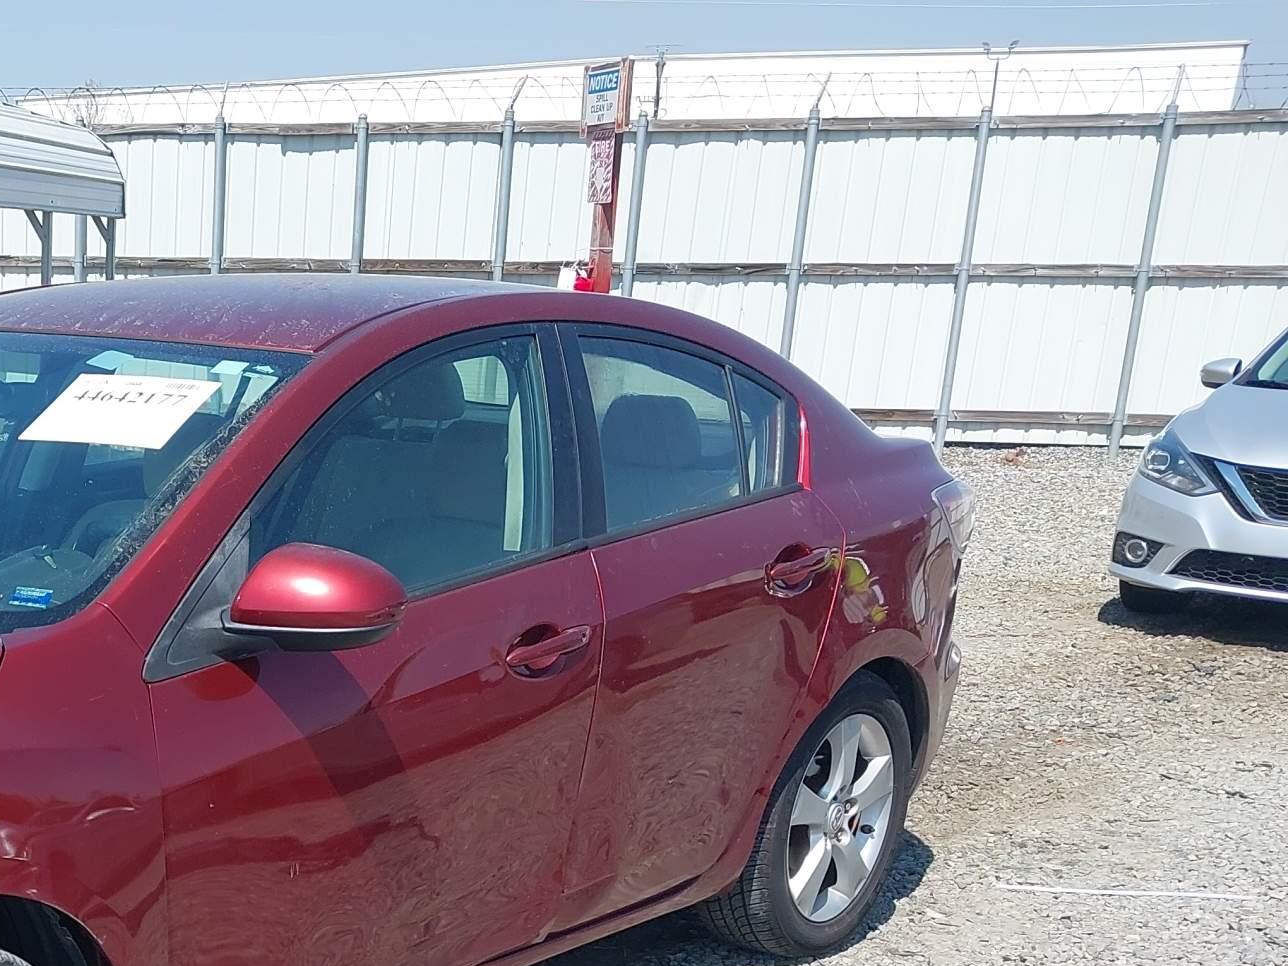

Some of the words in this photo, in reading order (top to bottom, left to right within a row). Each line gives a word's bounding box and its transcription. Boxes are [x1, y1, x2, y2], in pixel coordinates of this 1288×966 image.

[589, 72, 618, 92] NOTICE
[596, 94, 609, 103] SPILL
[591, 103, 605, 114] CLEAN
[606, 102, 614, 112] UP
[73, 389, 189, 406] 44642177
